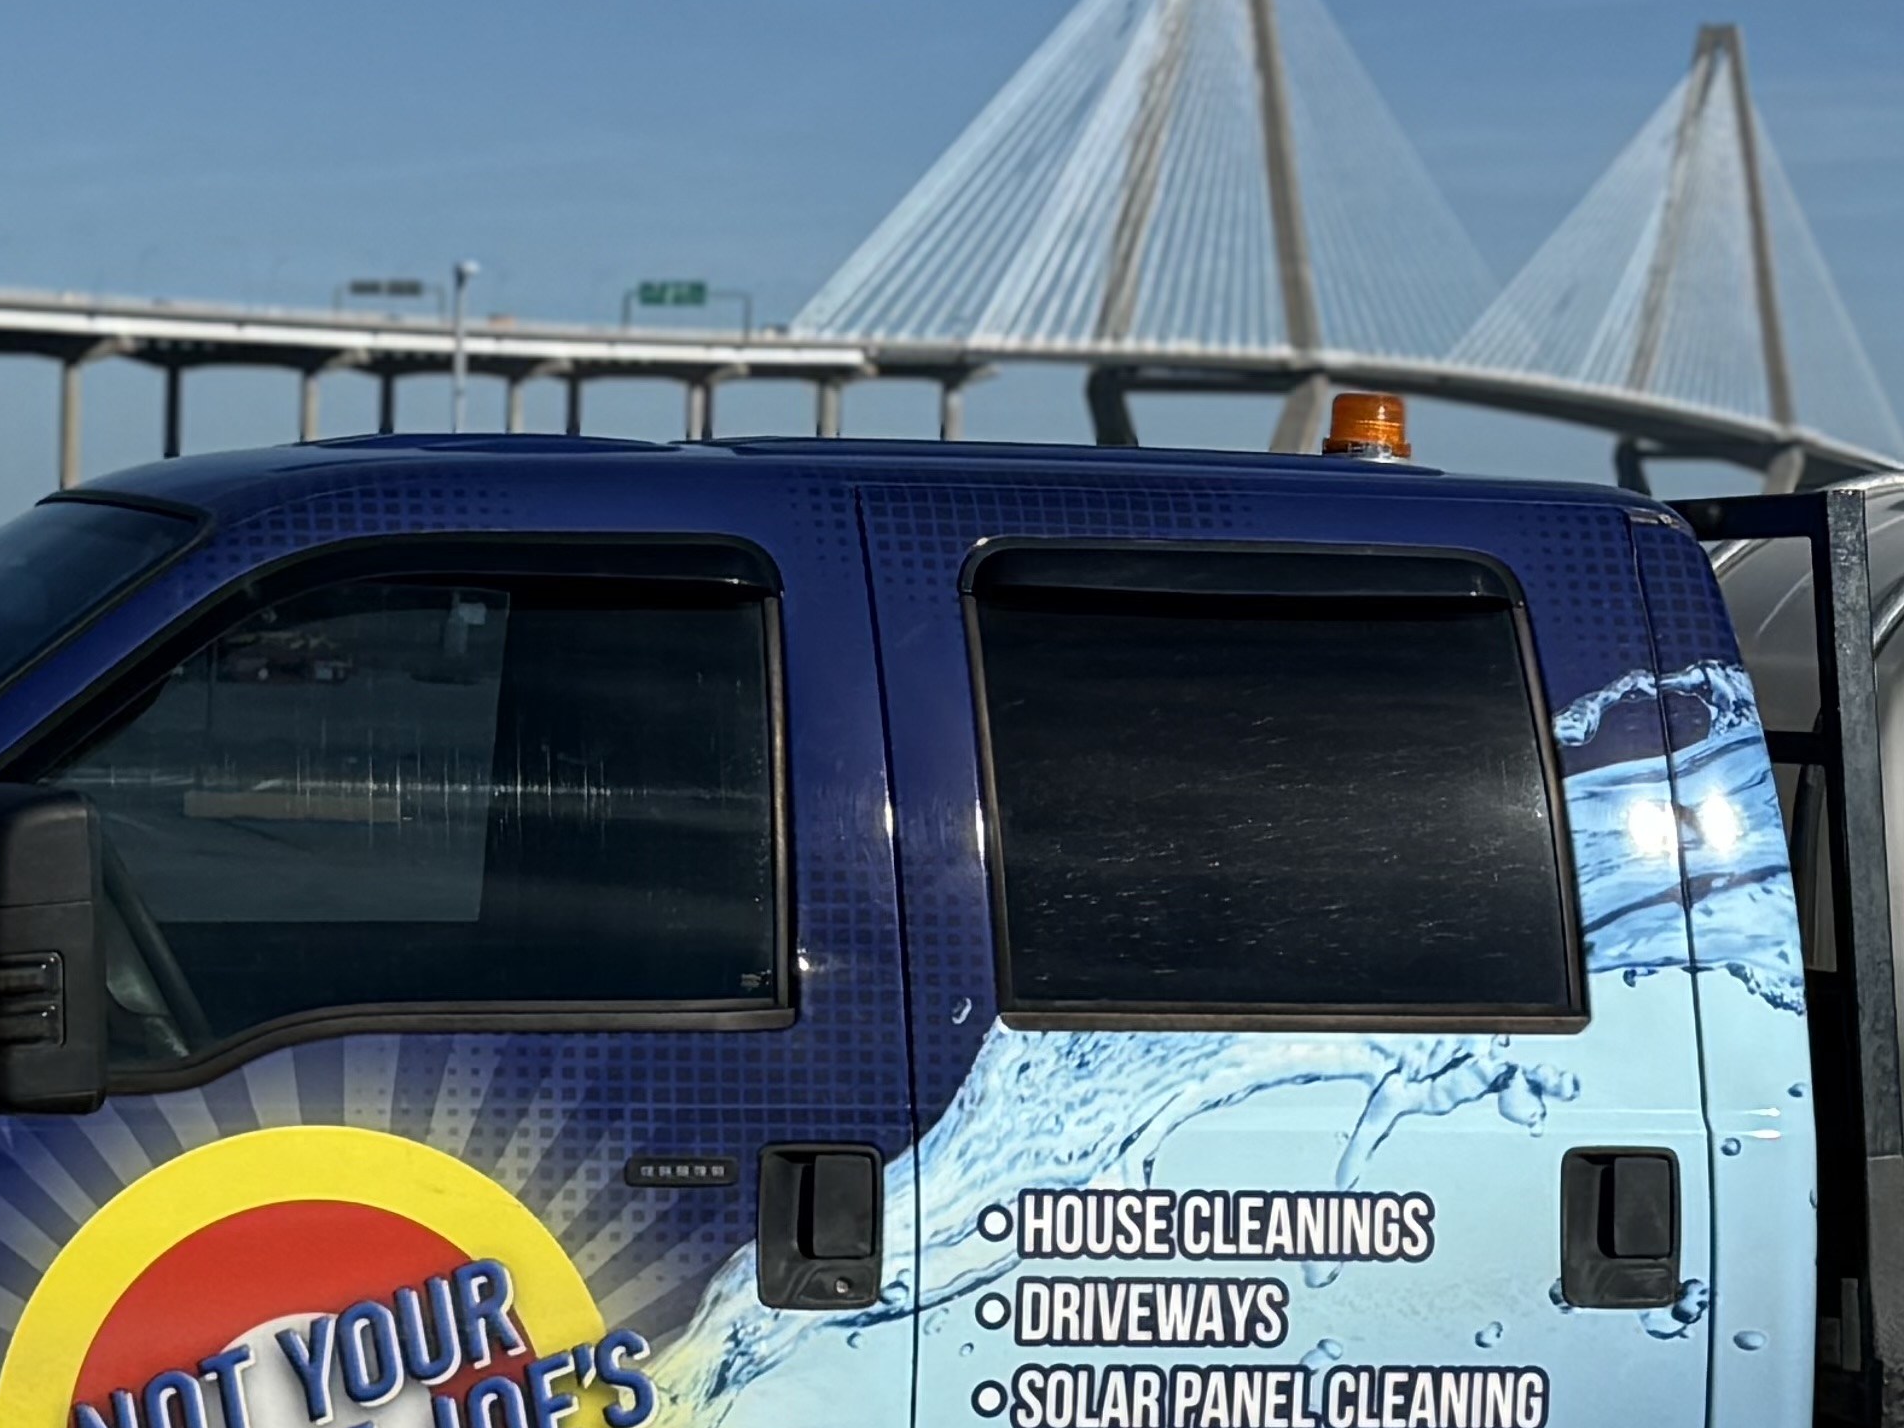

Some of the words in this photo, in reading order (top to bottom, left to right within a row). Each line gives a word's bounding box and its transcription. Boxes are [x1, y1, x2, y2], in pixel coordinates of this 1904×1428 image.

[1023, 1194, 1171, 1255] HOUSE
[1182, 1196, 1431, 1256] CLEANINGS
[278, 1257, 524, 1426] YOUR
[1021, 1282, 1284, 1344] DRIVEWAYS
